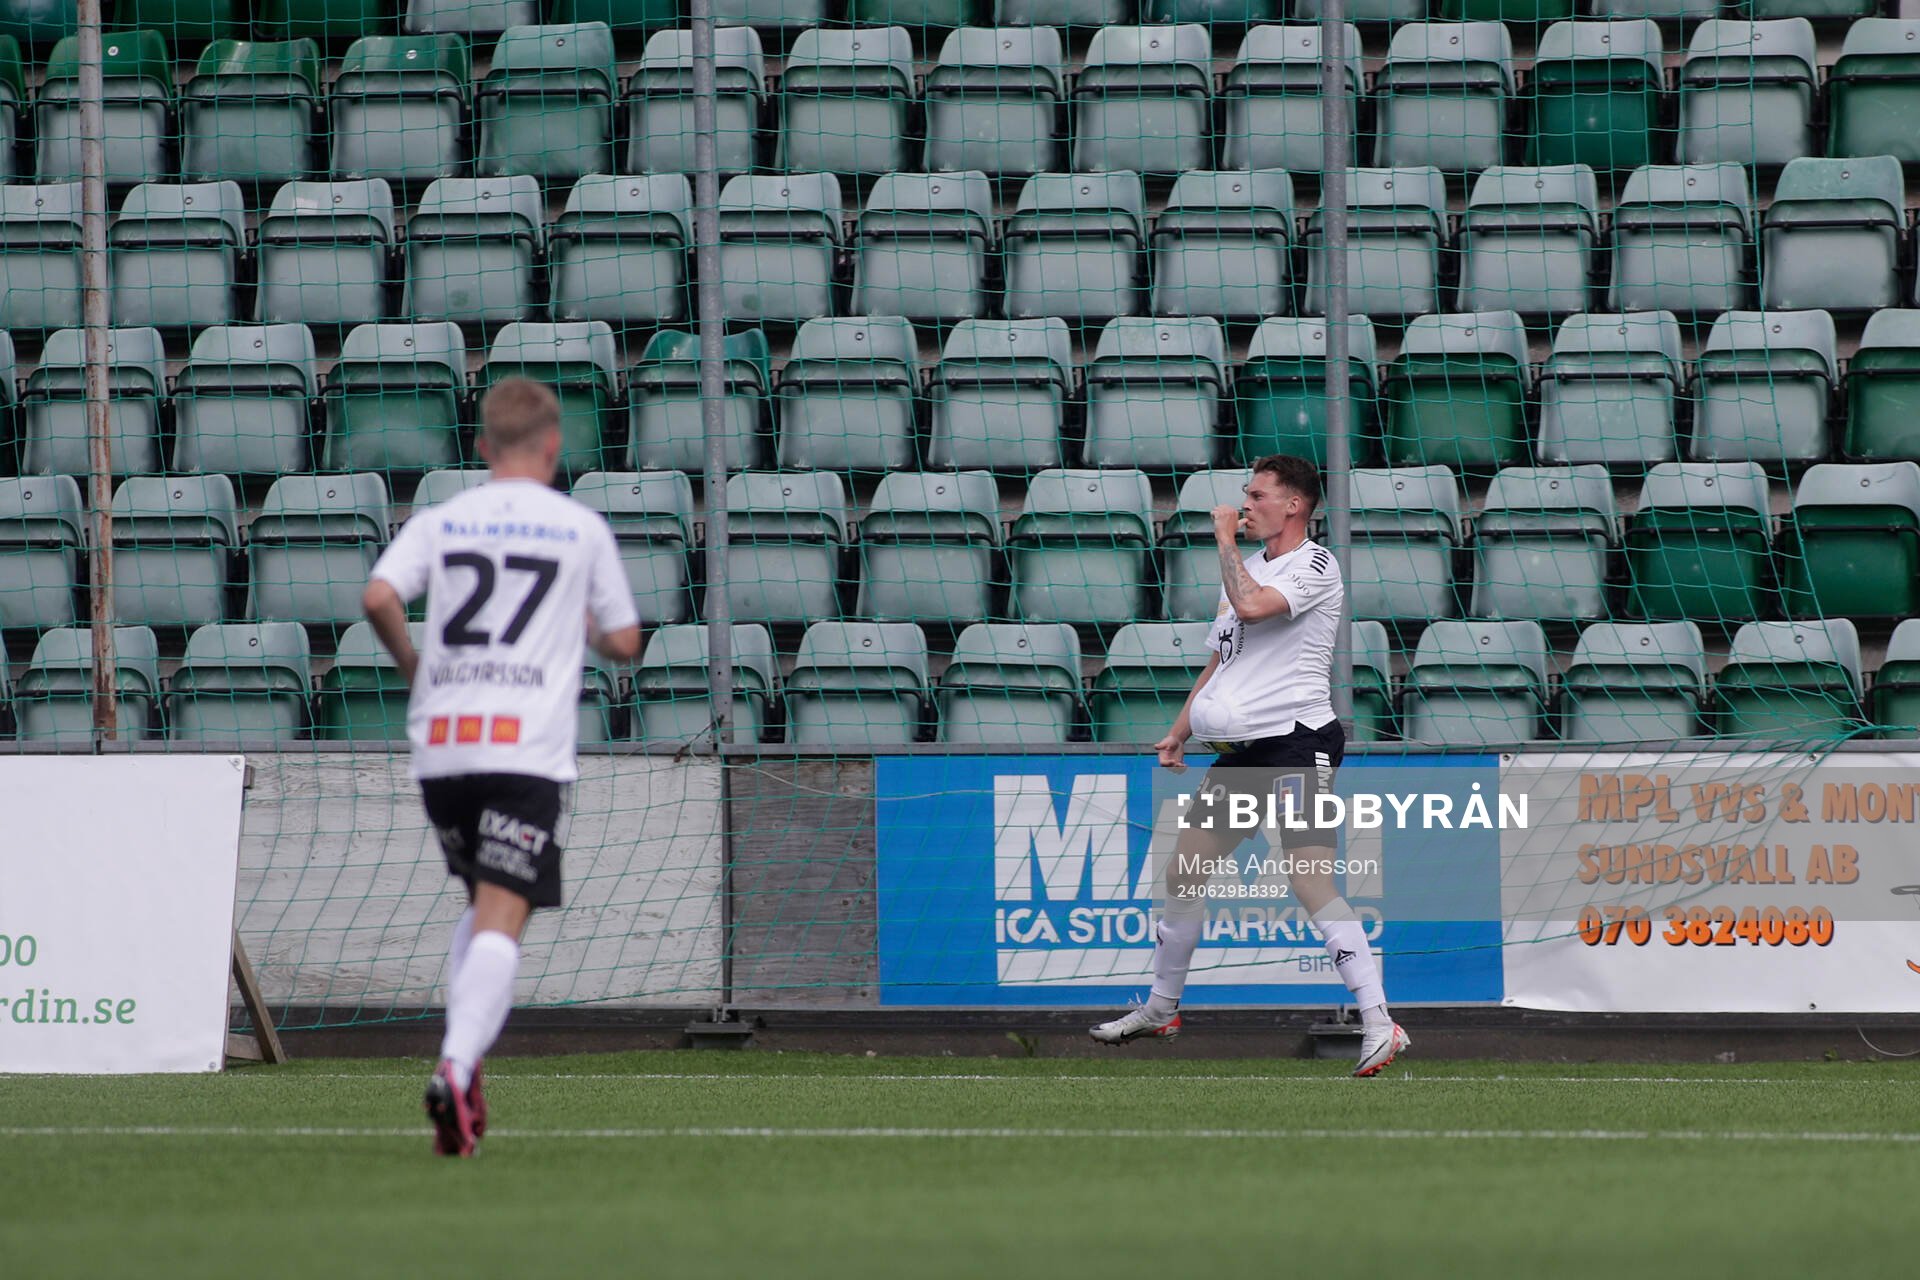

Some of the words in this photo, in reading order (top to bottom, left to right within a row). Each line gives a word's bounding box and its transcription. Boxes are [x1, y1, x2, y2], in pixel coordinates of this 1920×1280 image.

[442, 552, 560, 646] 27
[1577, 774, 1680, 823] MPL
[1690, 783, 1766, 823] VVS
[1778, 783, 1810, 823] &
[1577, 843, 1795, 884] SUNDSVALL
[1805, 844, 1859, 884] AB
[996, 908, 1060, 943] ICA
[1577, 906, 1652, 946] 070
[1662, 906, 1834, 946] 3824080
